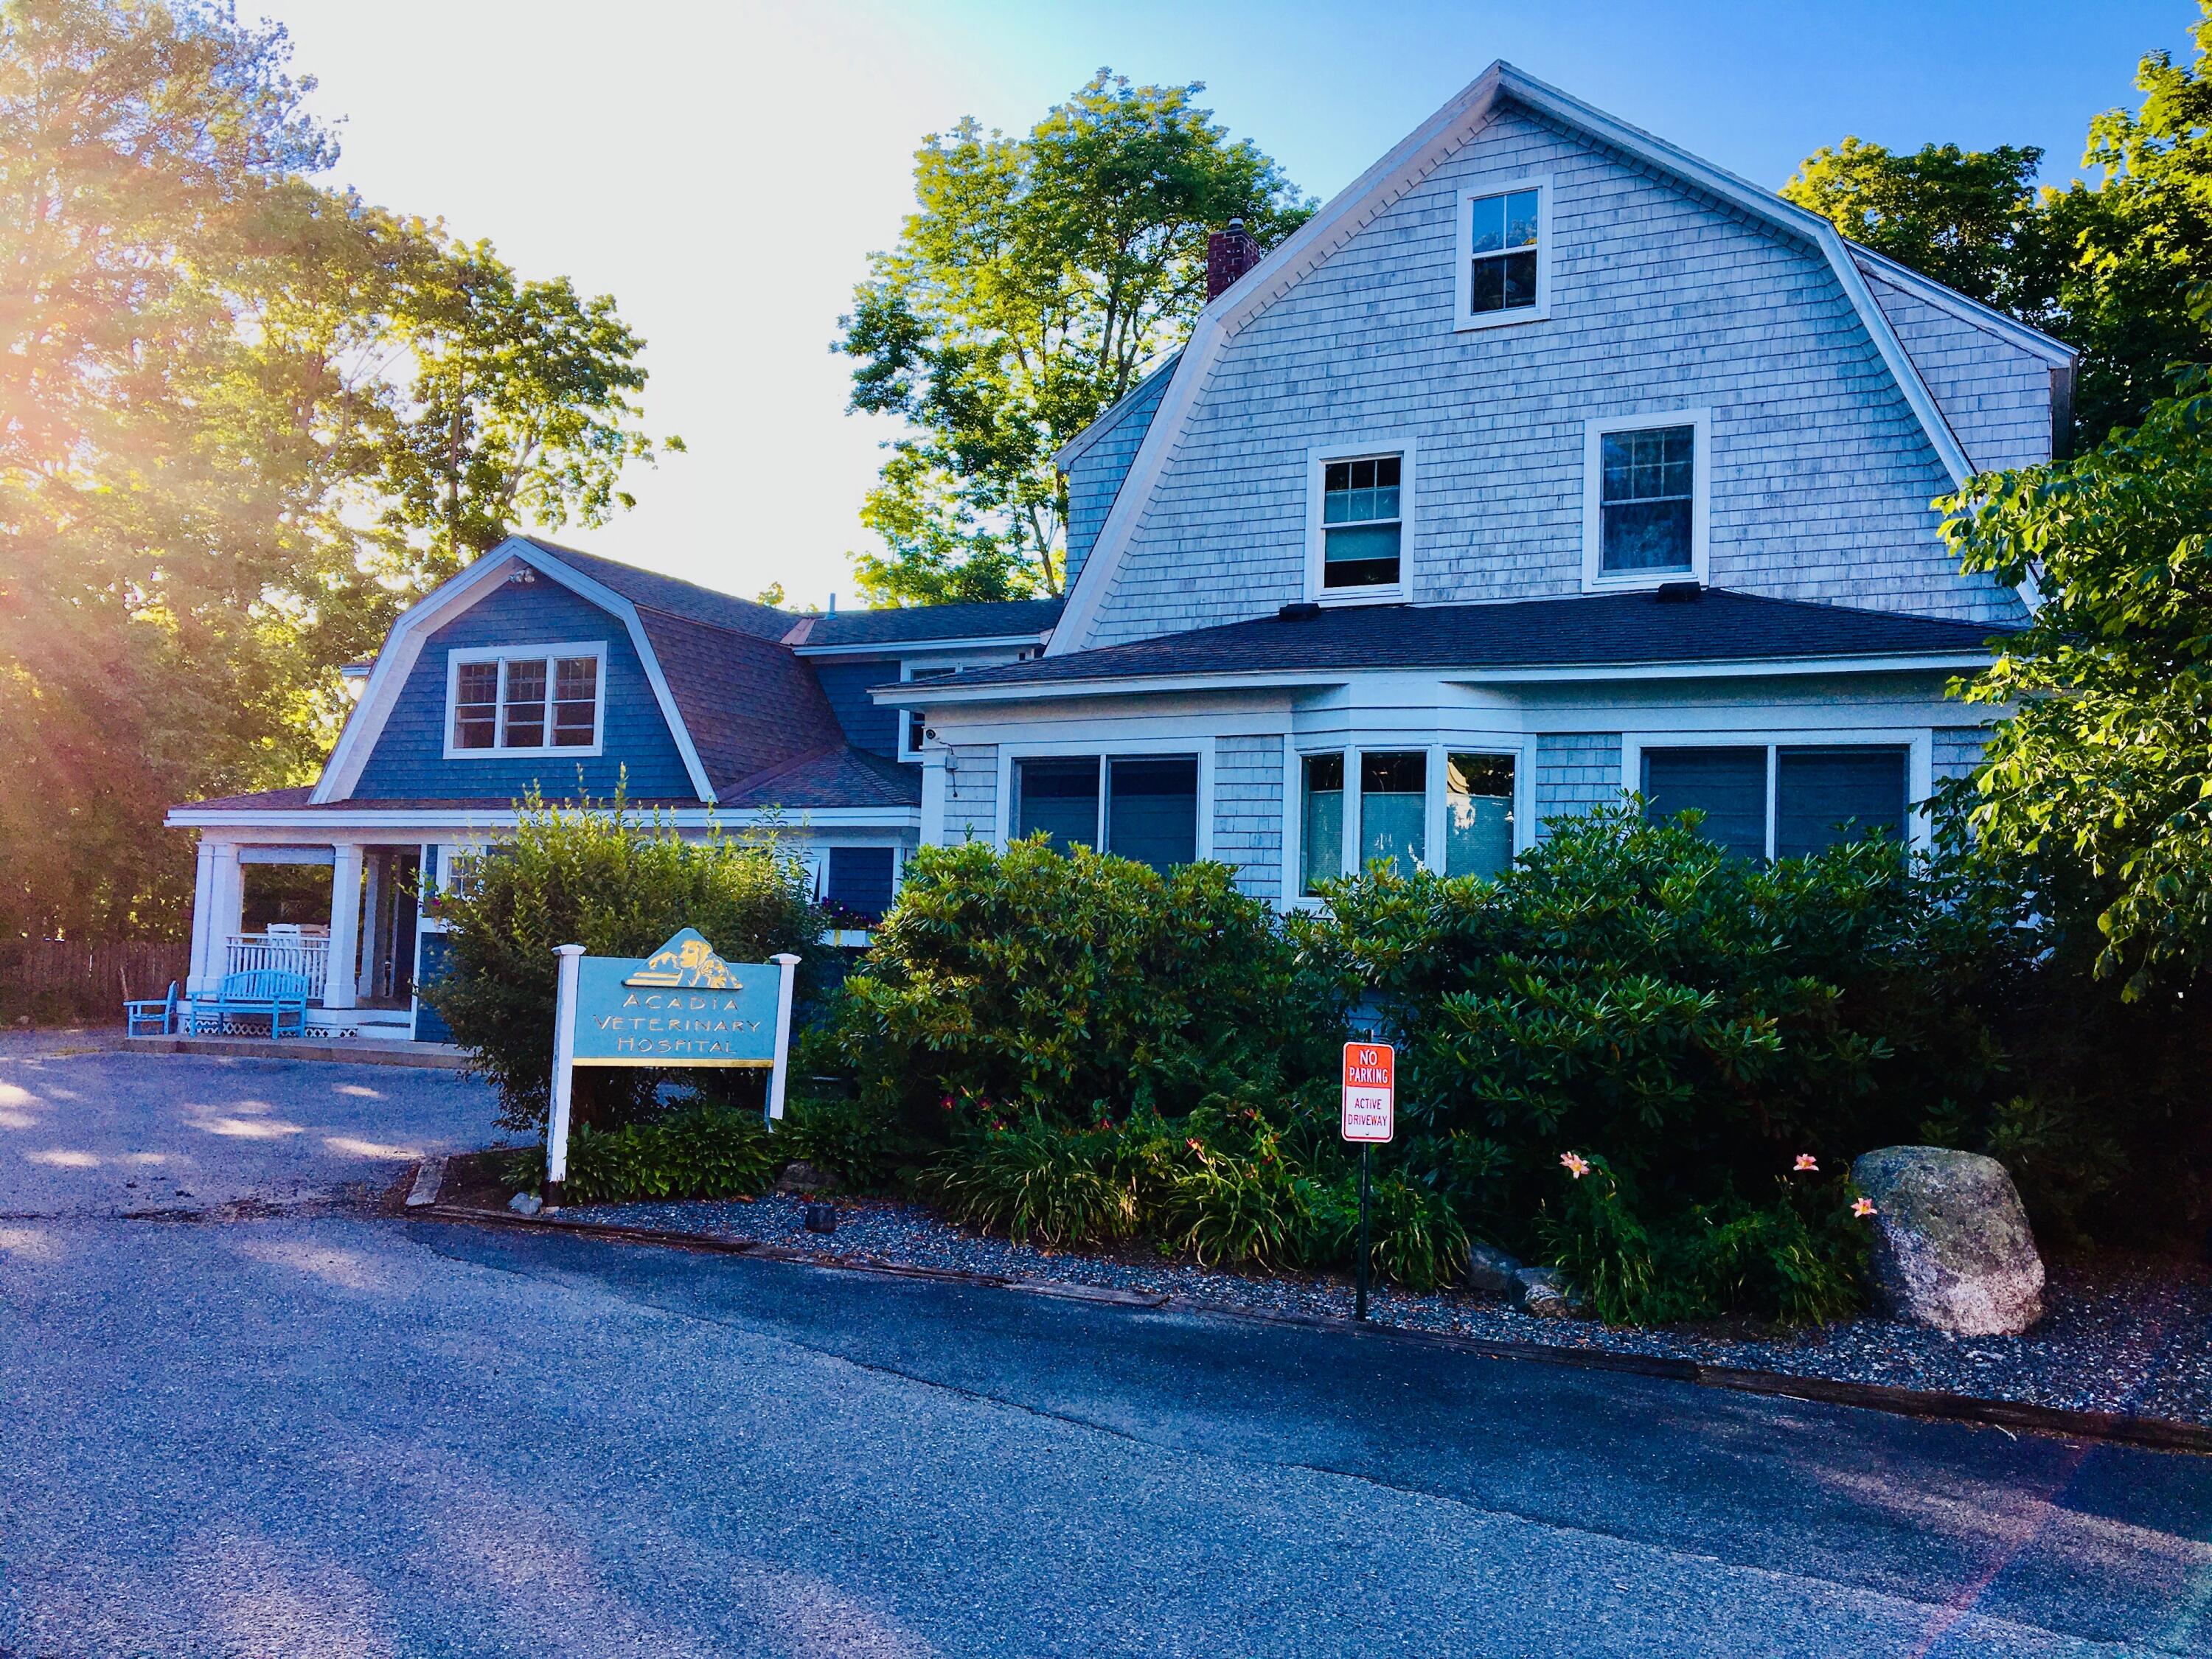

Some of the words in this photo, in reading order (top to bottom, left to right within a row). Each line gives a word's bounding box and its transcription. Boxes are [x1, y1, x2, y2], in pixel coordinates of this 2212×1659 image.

[622, 993, 738, 1010] ACADIA
[592, 1015, 761, 1032] VETERINARY
[617, 1036, 737, 1054] HOSPITAL
[1360, 1049, 1378, 1066] NO
[1349, 1066, 1388, 1084] PARKING
[1354, 1098, 1382, 1110] ACTIVE
[1348, 1114, 1388, 1126] DRIVEWAY
